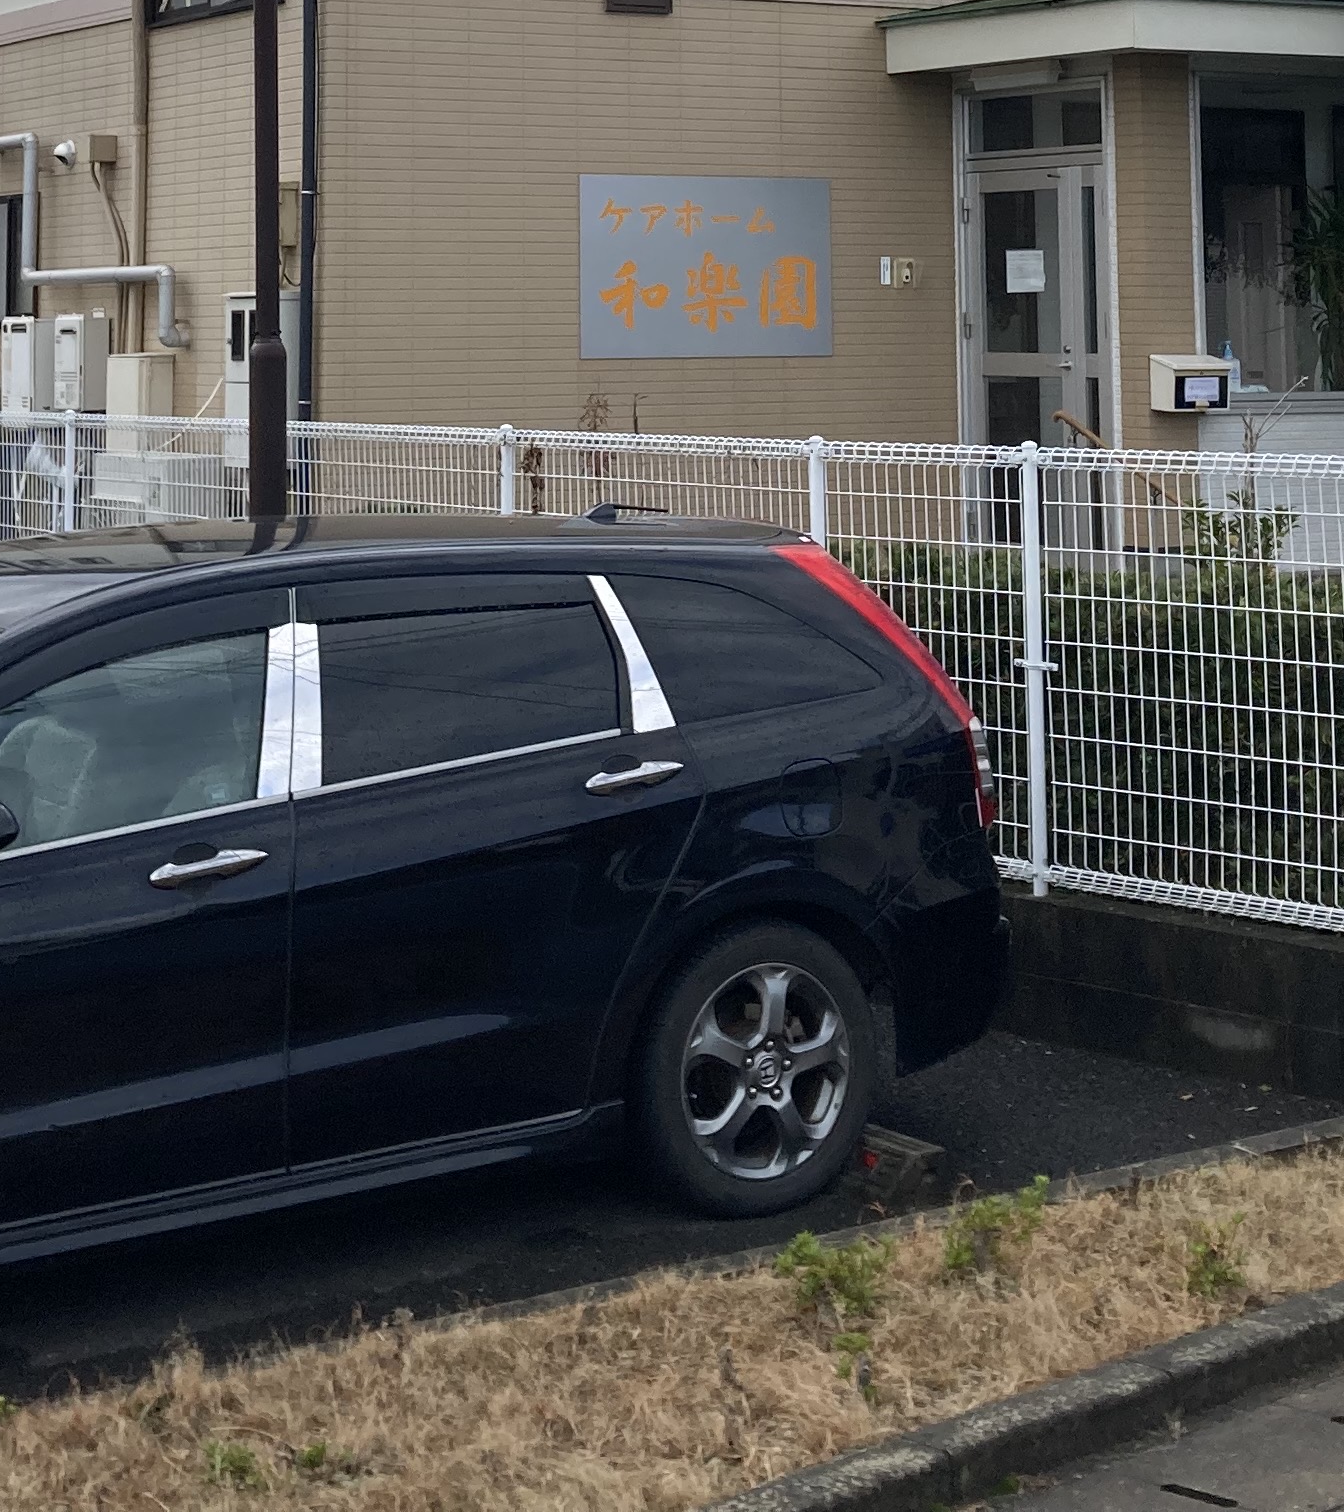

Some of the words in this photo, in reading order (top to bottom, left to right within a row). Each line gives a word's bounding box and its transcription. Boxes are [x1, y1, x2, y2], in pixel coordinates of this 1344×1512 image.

[599, 198, 776, 237] ケアホーム
[598, 251, 817, 334] 和楽園
